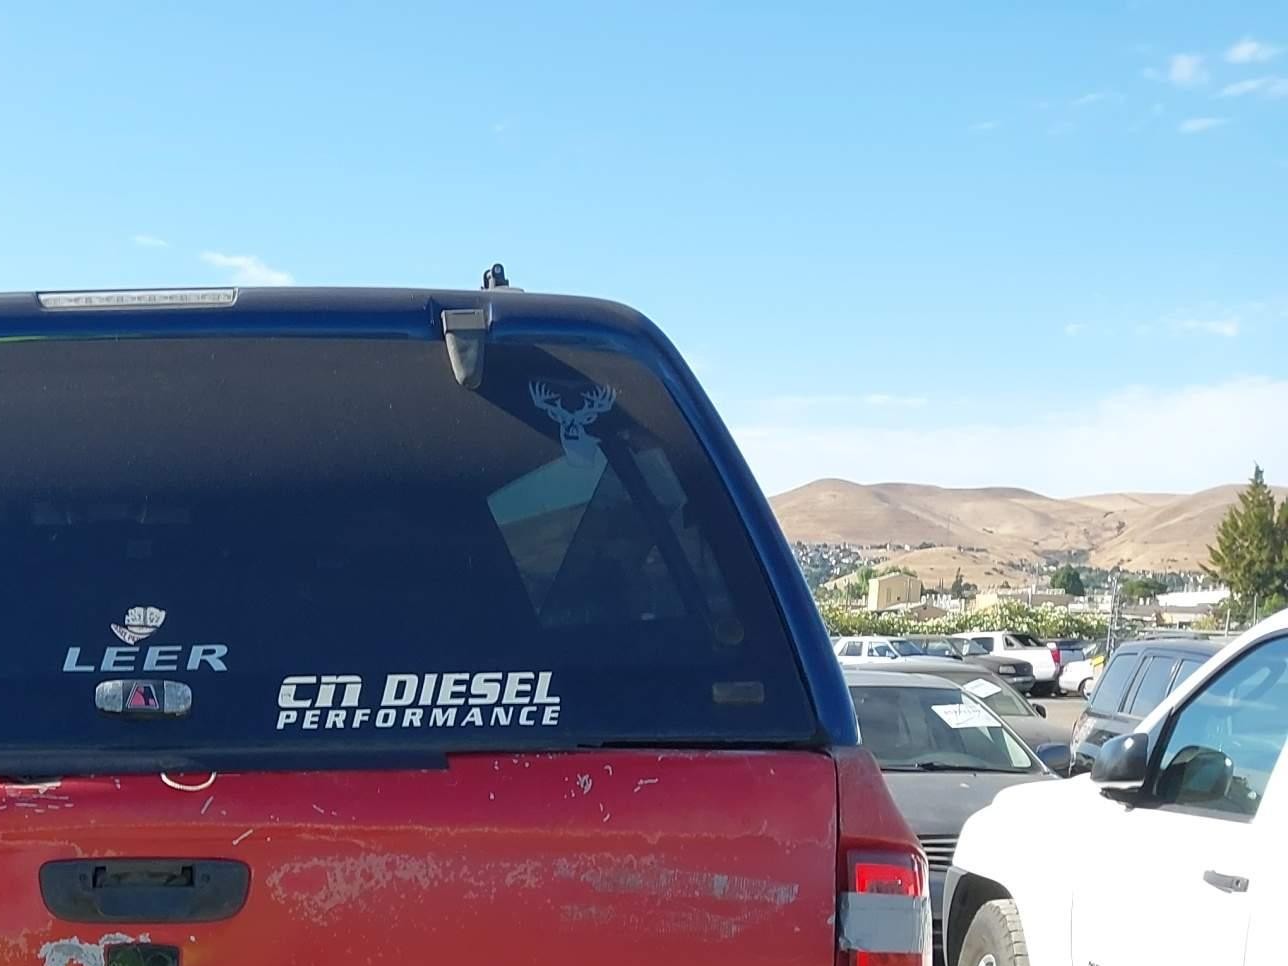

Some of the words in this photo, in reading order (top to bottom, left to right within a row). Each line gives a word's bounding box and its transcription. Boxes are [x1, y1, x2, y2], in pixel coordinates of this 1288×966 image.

[62, 645, 229, 672] LEER
[380, 672, 561, 707] DIESEL
[276, 706, 561, 730] PERFORMANCE
